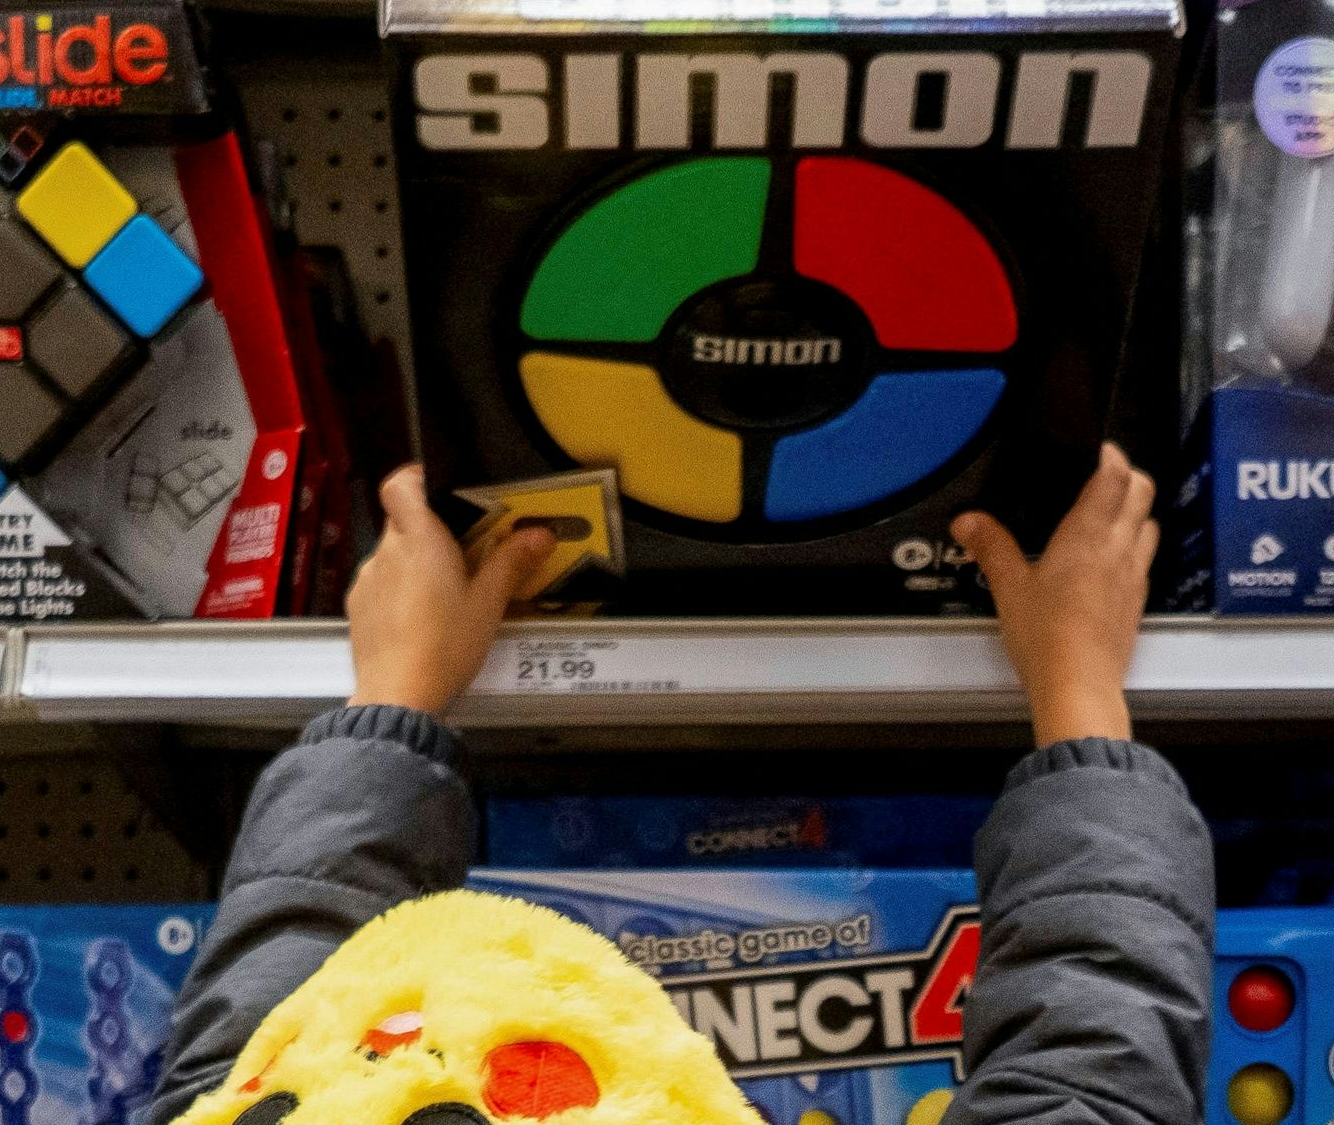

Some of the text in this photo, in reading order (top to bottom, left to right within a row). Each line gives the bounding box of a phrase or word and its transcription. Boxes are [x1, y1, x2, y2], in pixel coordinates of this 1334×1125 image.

[47, 87, 124, 108] MATCH
[31, 559, 63, 579] the
[1227, 569, 1297, 587] MOTION
[25, 579, 87, 599] Blocks
[19, 600, 76, 621] Lights
[517, 659, 596, 681] 21.99
[739, 923, 832, 964] game
[834, 913, 871, 947] of
